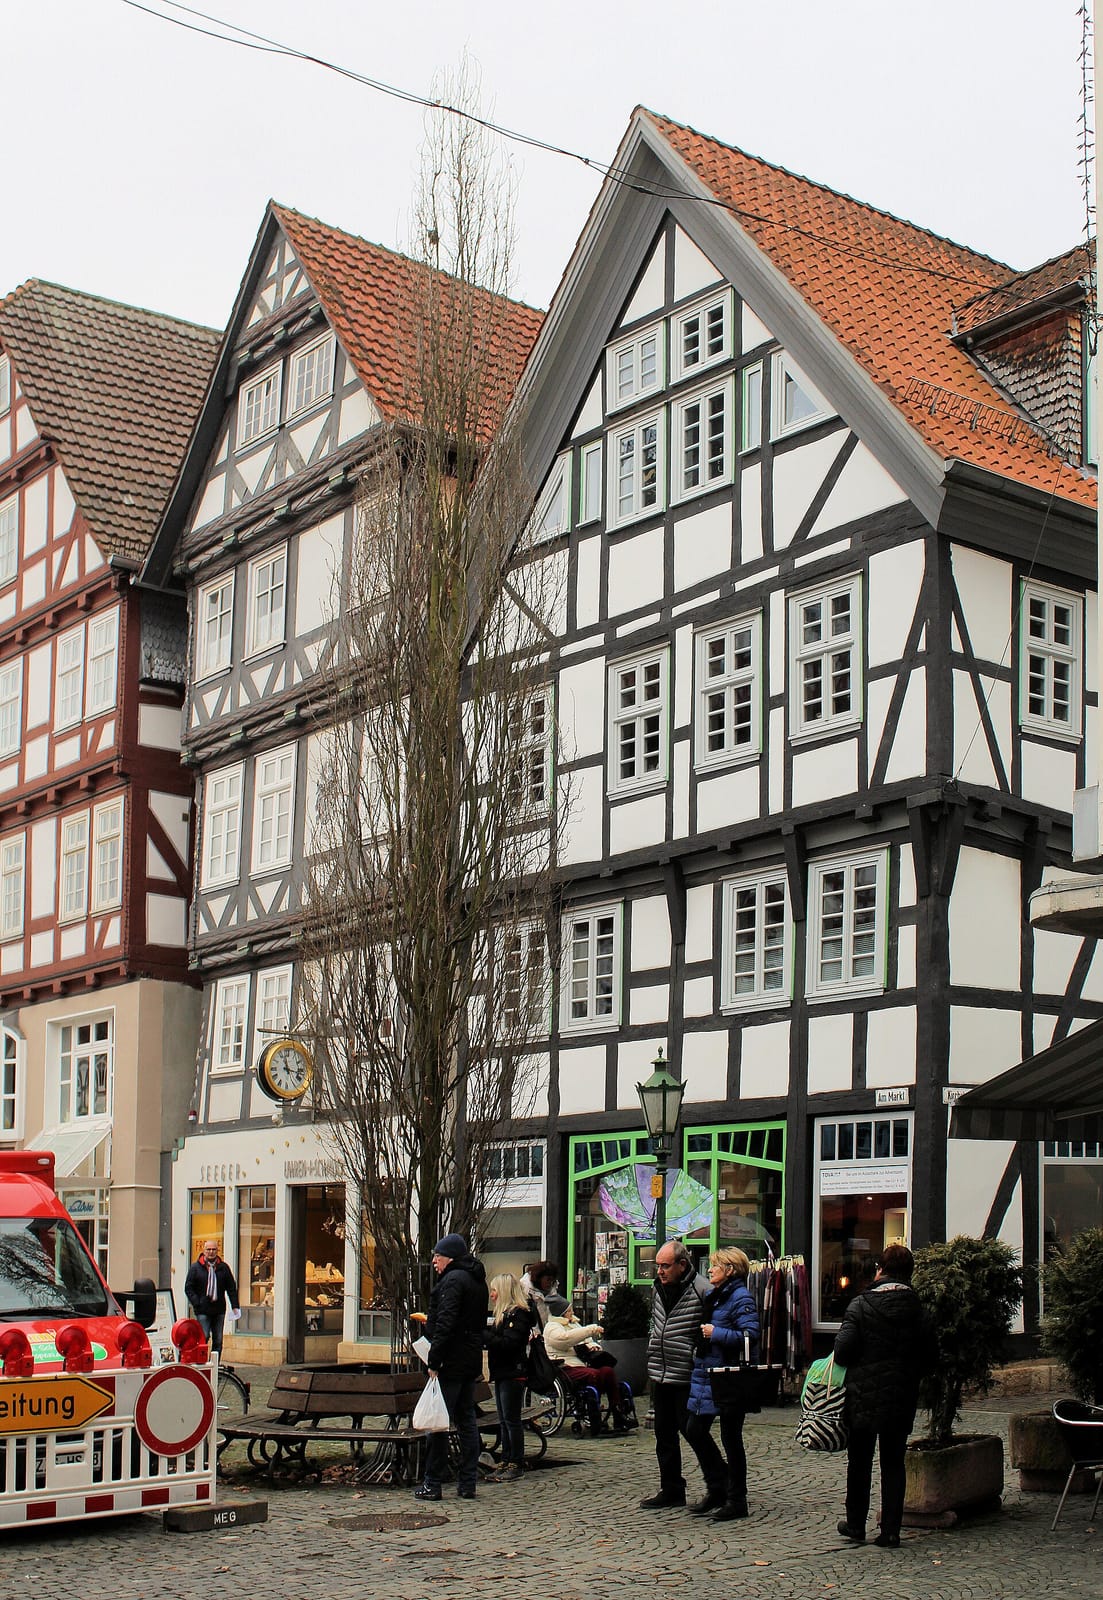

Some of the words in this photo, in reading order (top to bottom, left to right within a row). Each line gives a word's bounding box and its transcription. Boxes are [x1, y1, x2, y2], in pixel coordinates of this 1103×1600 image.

[200, 1163, 241, 1182] SEEGER
[0, 1392, 75, 1420] eitung
[213, 1511, 237, 1525] MEG
